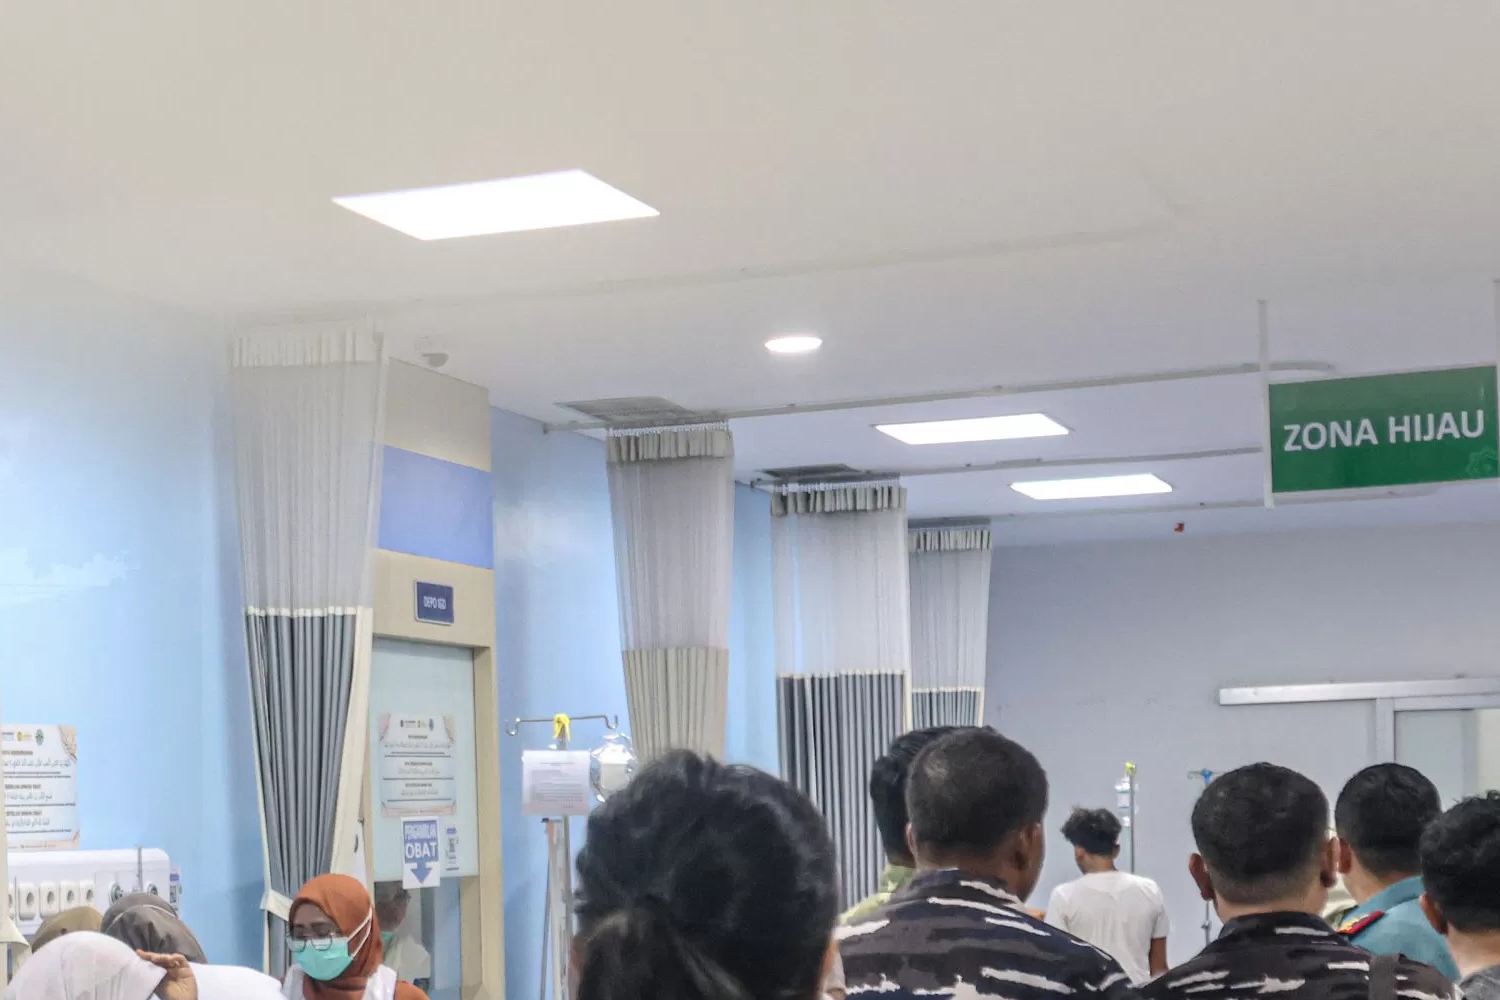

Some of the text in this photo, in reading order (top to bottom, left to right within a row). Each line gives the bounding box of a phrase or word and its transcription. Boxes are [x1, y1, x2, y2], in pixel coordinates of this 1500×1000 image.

[1283, 409, 1485, 452] ZONA HIJAU
[423, 596, 438, 609] DEPO
[405, 842, 438, 859] OBAT
